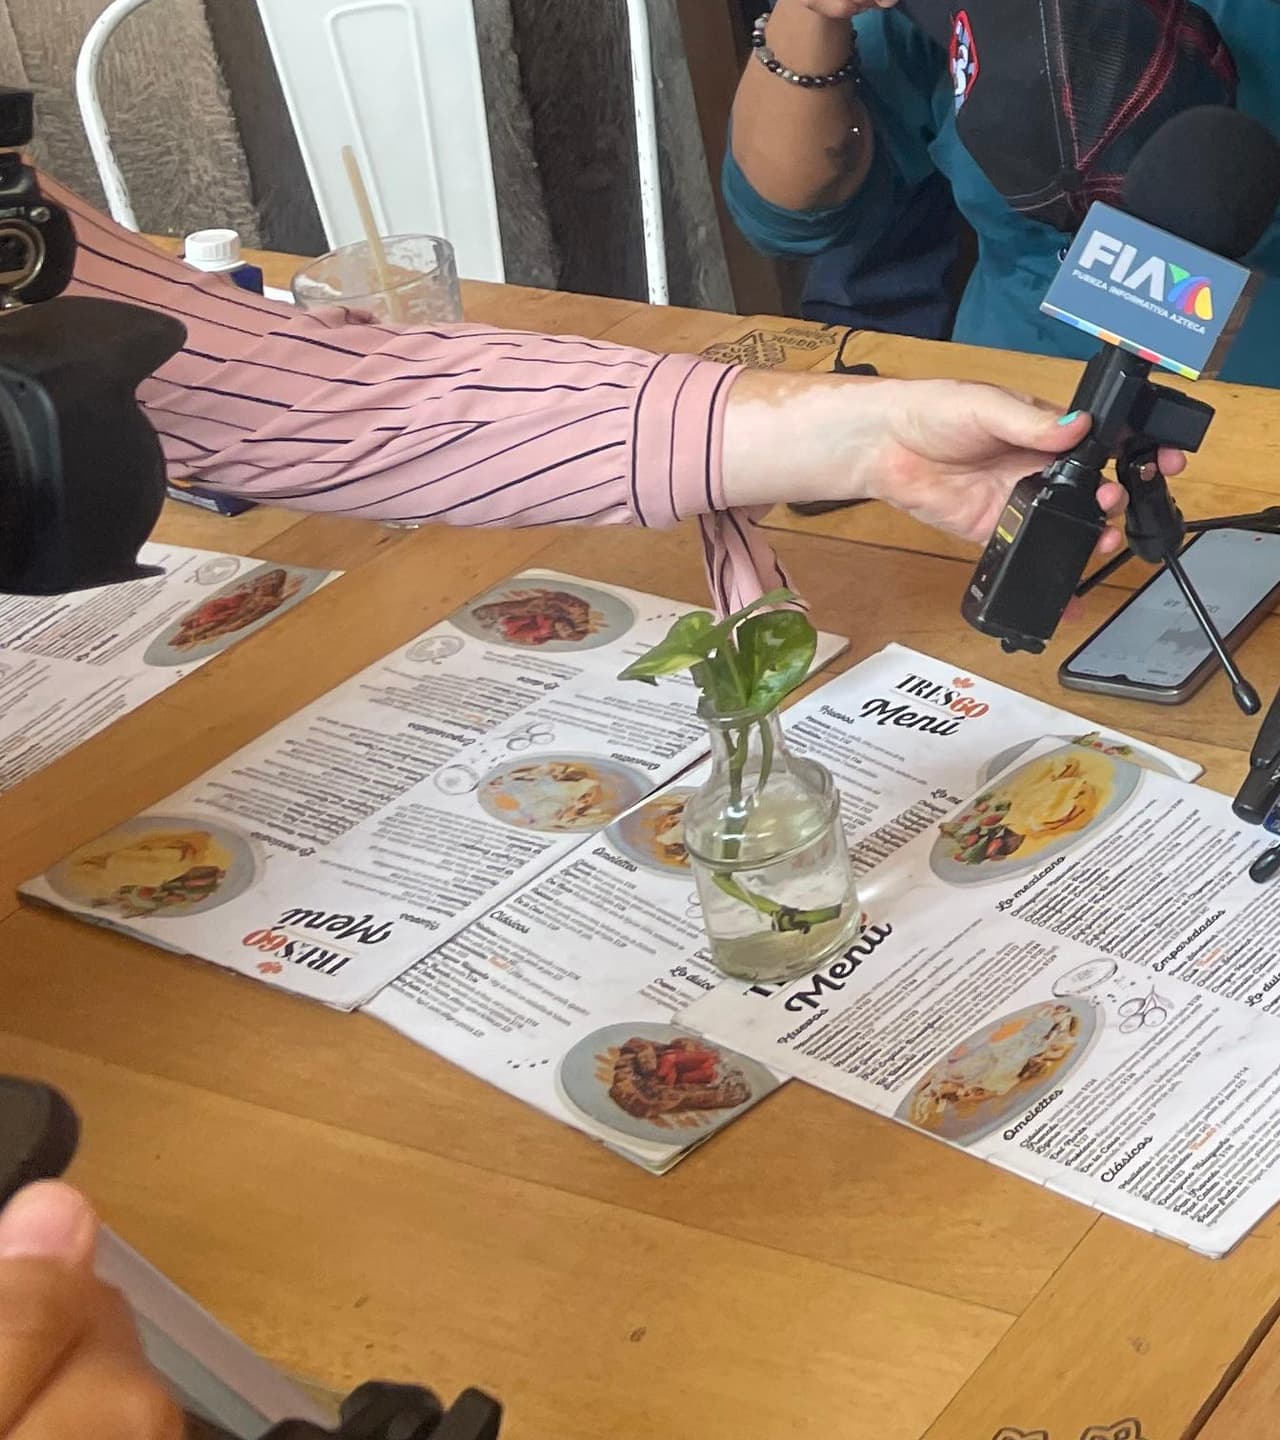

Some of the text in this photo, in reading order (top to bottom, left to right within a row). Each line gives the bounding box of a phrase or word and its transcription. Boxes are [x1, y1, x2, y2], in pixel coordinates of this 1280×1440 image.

[861, 694, 969, 737] Menú
[897, 674, 989, 722] TRES60
[278, 908, 395, 945] Menú
[1151, 909, 1227, 973] Emparedados
[784, 921, 893, 1012] Menú
[1002, 1089, 1064, 1141] Omelettes
[1100, 1135, 1154, 1183] Clásicos
